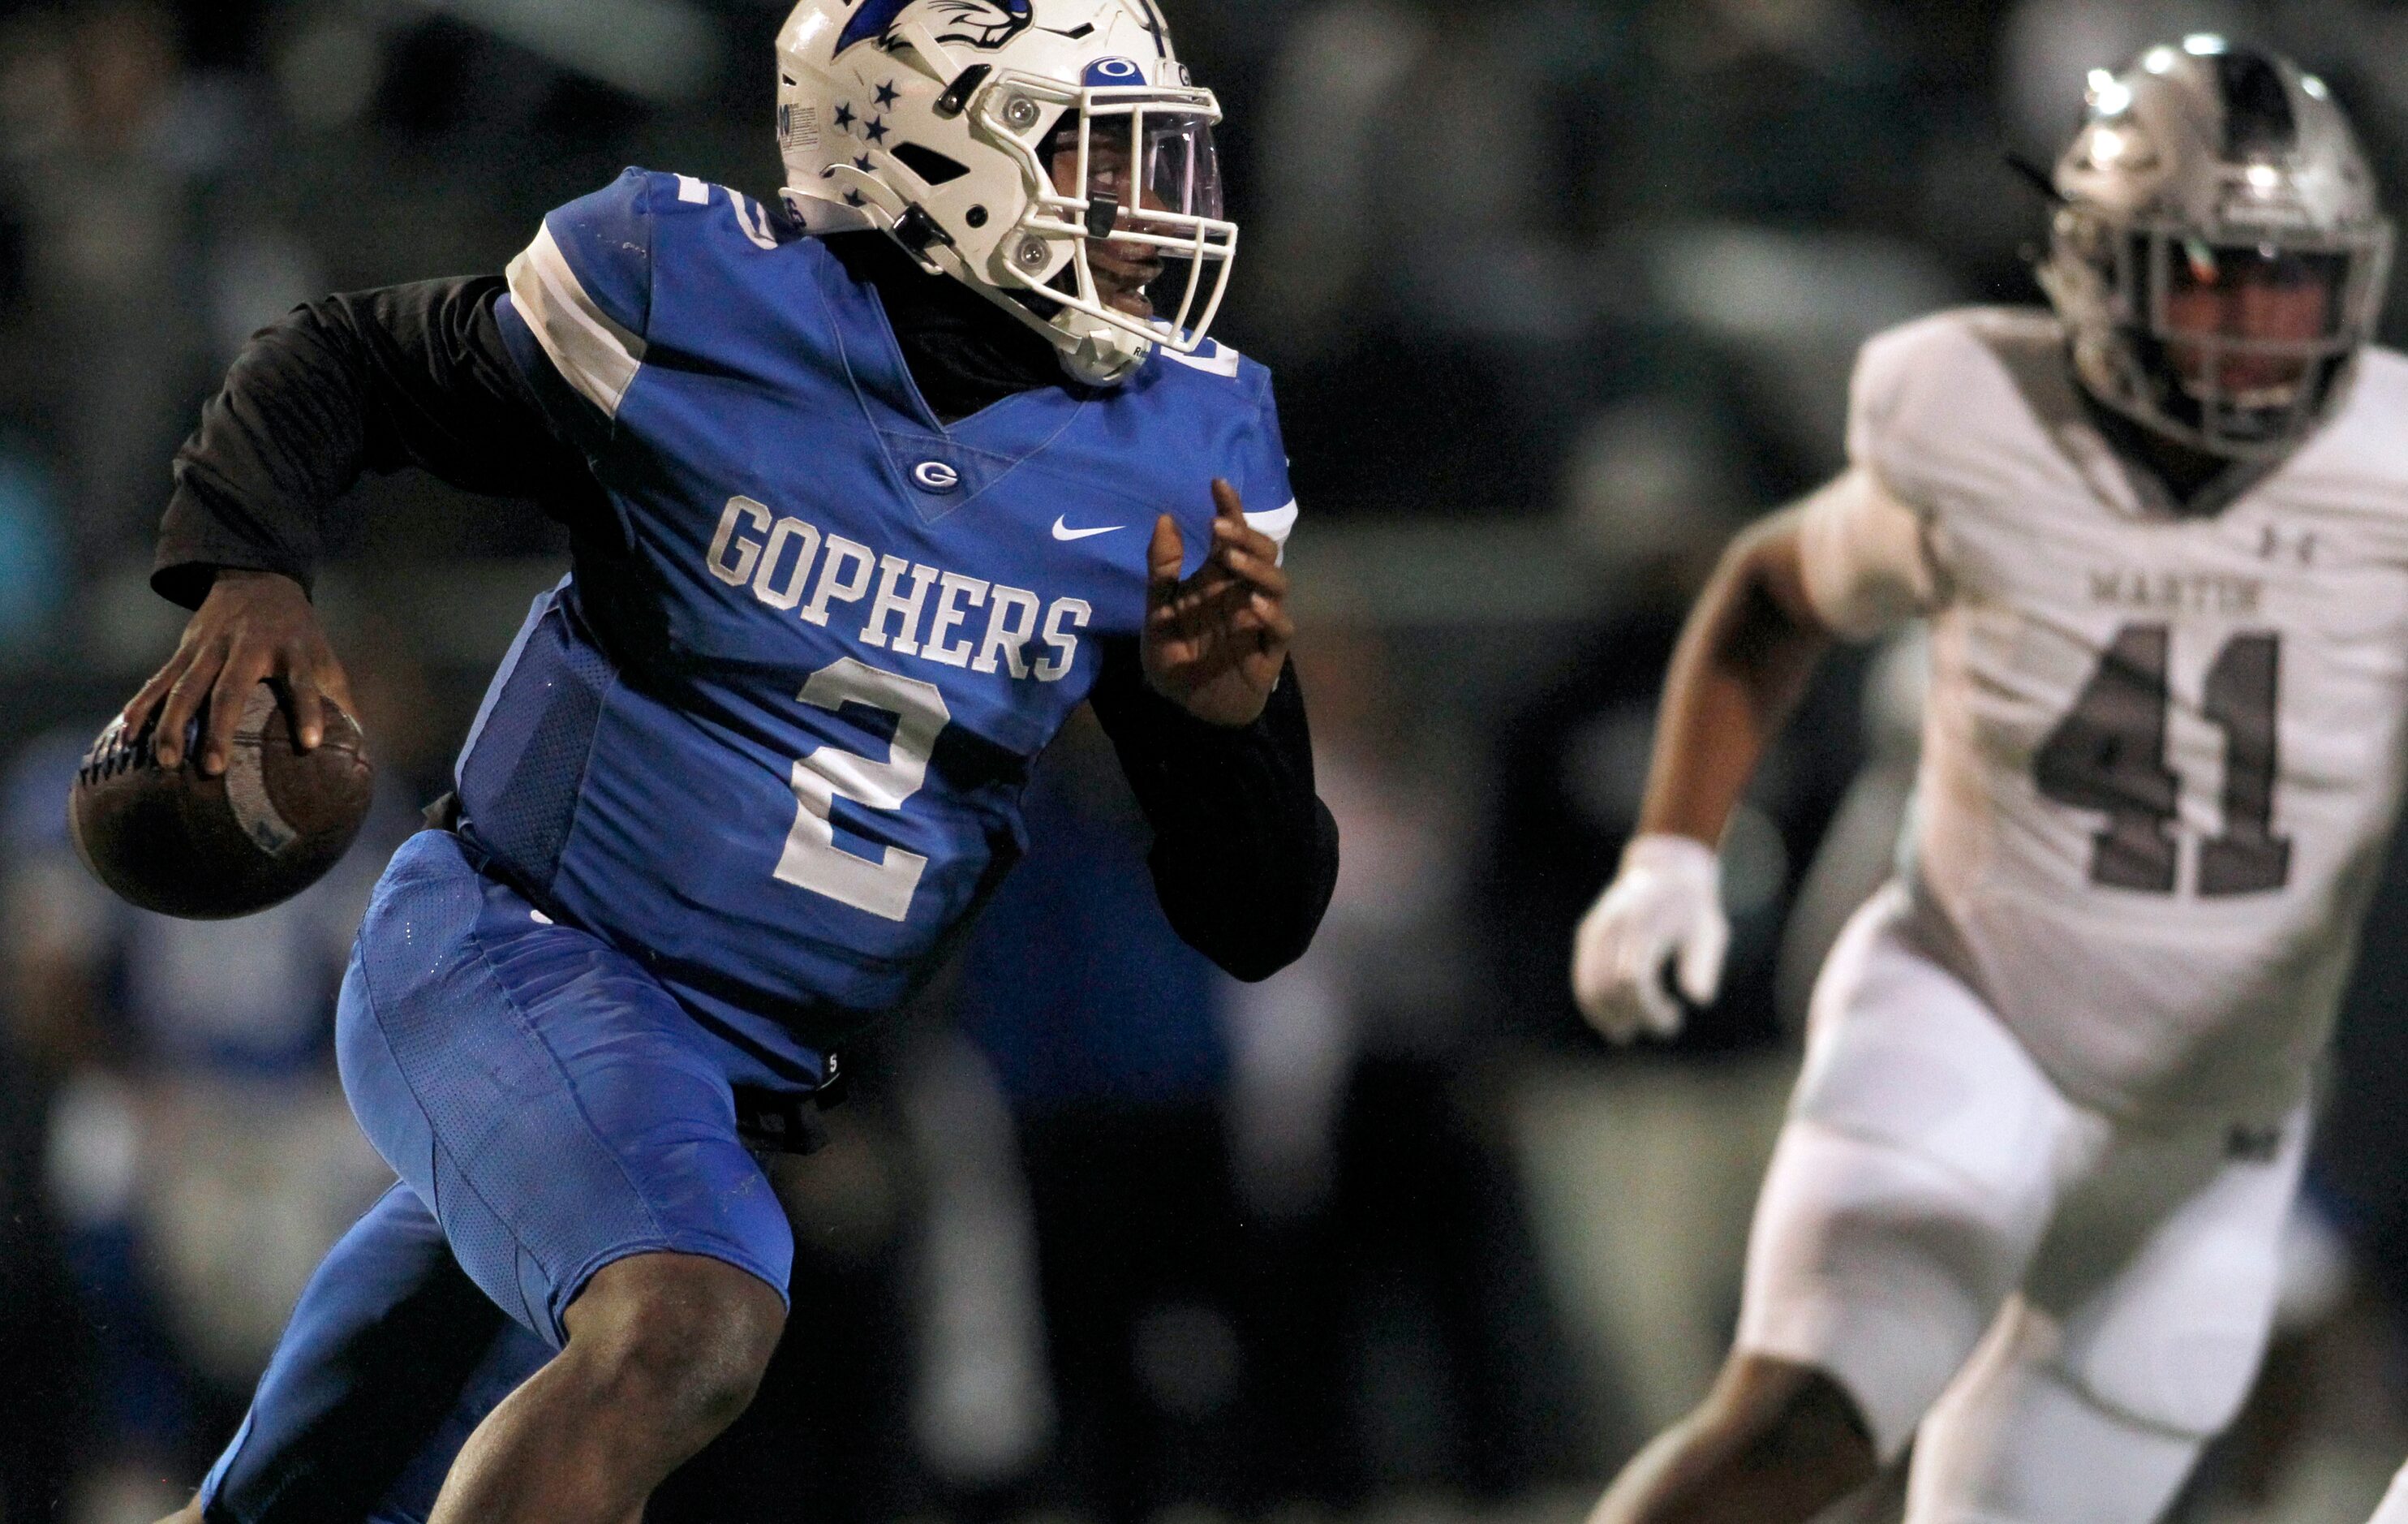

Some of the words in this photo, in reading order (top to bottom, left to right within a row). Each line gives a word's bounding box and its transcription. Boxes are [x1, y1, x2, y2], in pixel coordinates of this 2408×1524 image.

[916, 462, 957, 487] G
[706, 495, 1092, 682] GOPHERS
[773, 657, 951, 922] 2
[2033, 621, 2294, 896] 41
